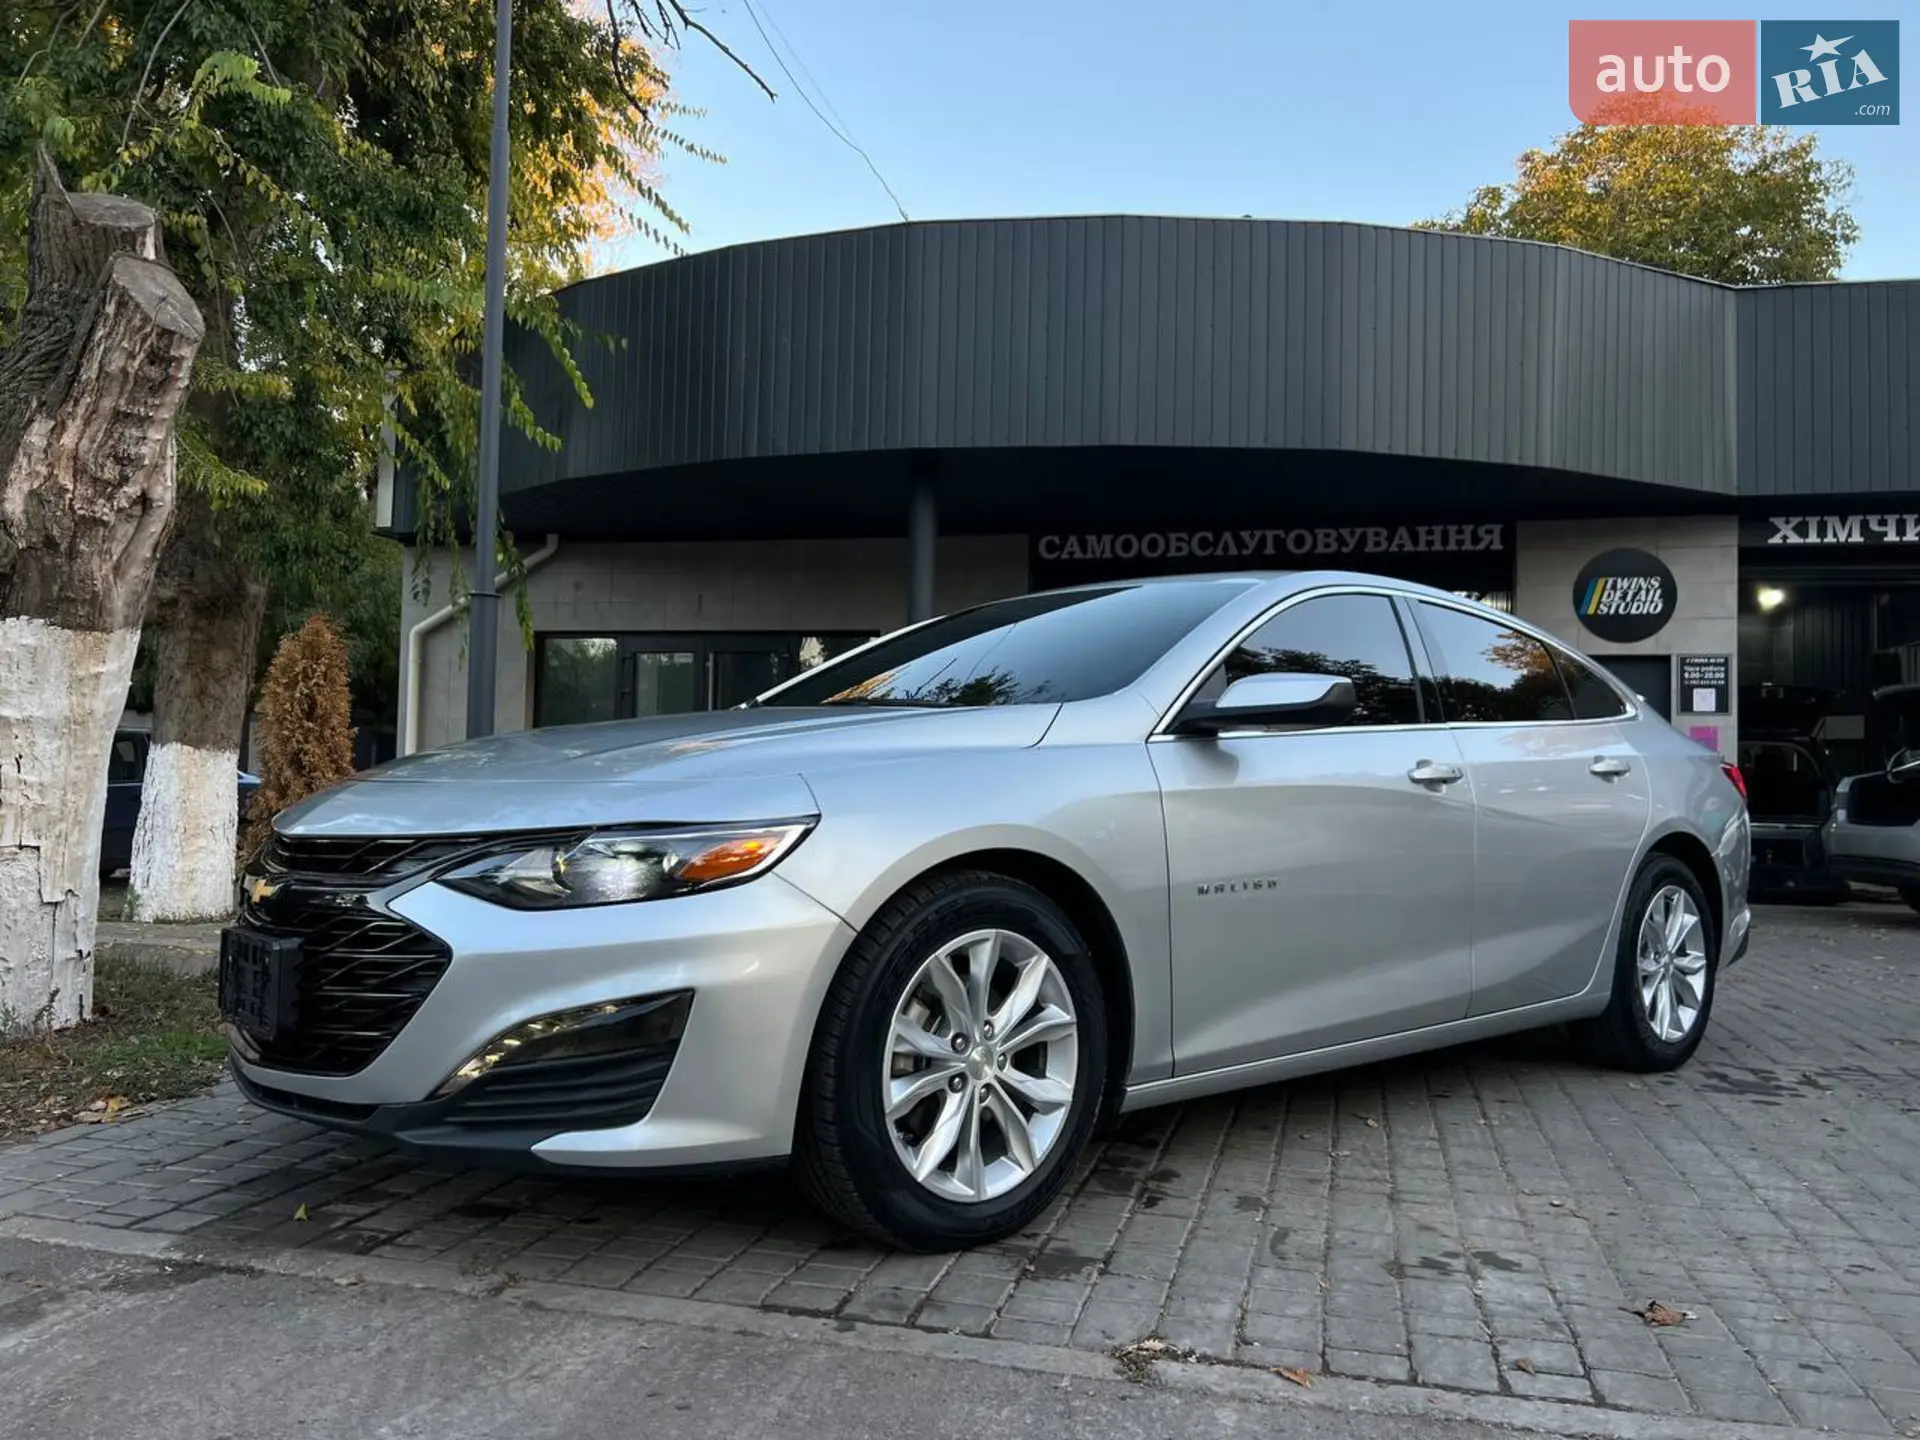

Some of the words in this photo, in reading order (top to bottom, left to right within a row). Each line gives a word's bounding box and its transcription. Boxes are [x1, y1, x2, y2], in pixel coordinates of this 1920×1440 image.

[1038, 524, 1505, 560] САМООБСЛУГОВУВАННЯ
[1604, 576, 1662, 590] TWINS
[1601, 588, 1664, 602] DETAIL
[1597, 601, 1664, 615] STUDIO
